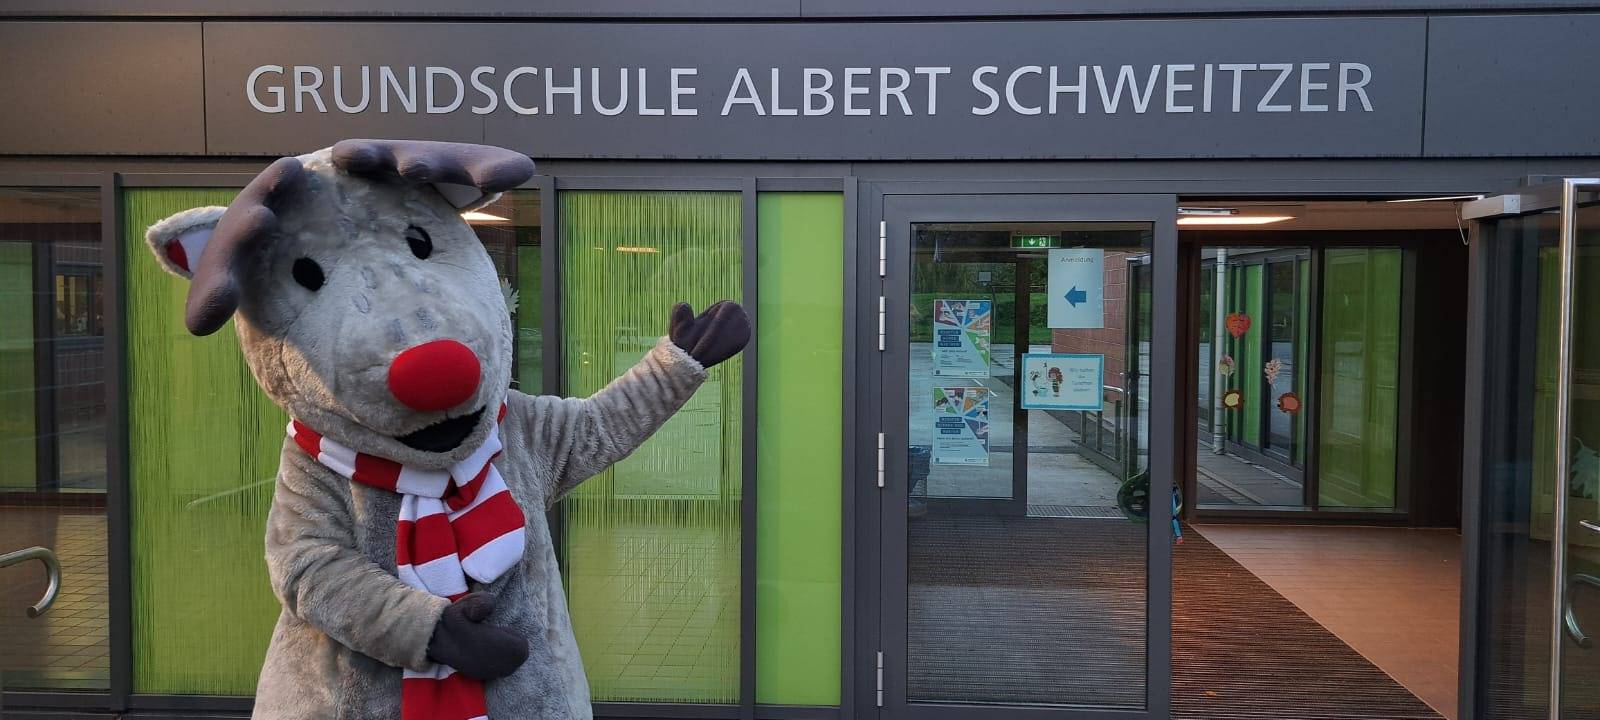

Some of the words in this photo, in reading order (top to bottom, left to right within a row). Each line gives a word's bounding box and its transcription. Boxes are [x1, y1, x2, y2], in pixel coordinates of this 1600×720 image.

[246, 65, 699, 116] GRUNDSCHULE
[721, 66, 951, 116] ALBERT
[971, 62, 1374, 115] SCHWEITZER
